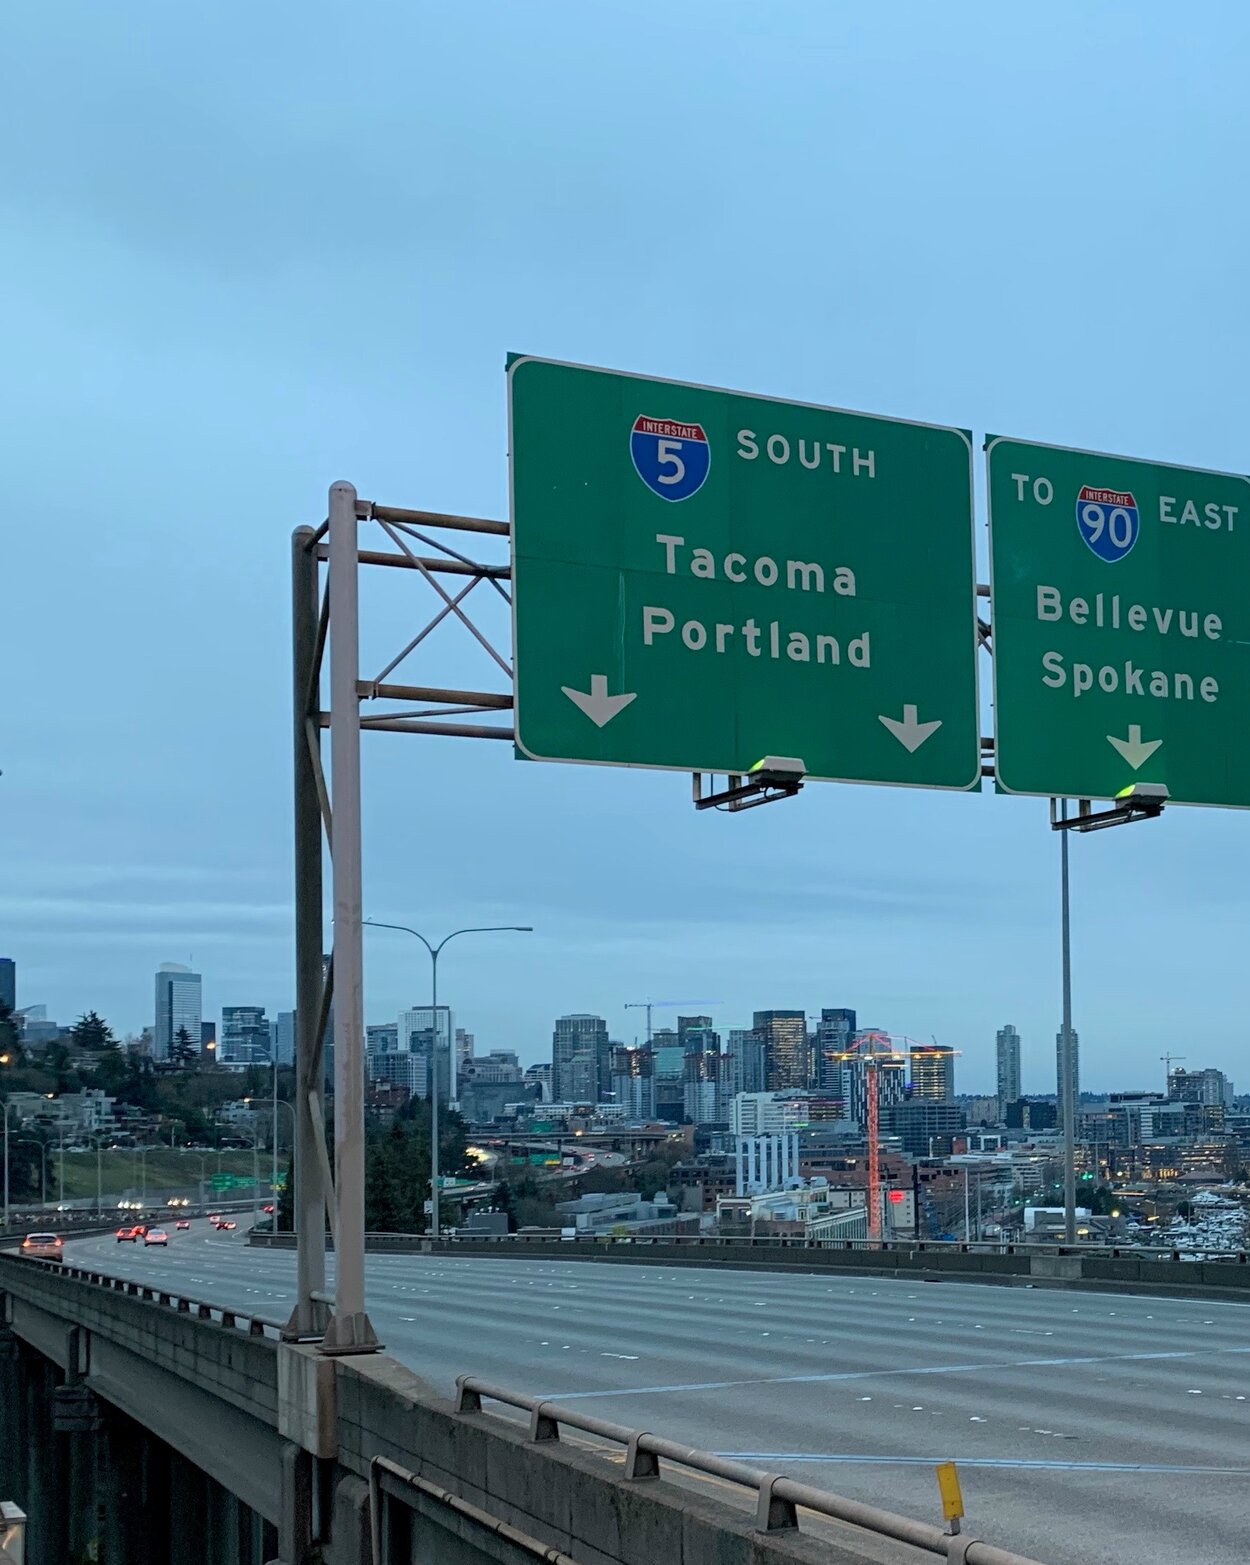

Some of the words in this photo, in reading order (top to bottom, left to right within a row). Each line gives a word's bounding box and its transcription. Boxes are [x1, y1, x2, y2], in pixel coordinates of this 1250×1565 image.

[643, 421, 697, 438] INTERSTATE
[658, 439, 685, 484] 5
[737, 429, 876, 478] SOUTH
[1011, 473, 1054, 505] TO
[1085, 490, 1129, 505] INTERSTATE
[1082, 504, 1132, 548] 90
[1159, 496, 1239, 531] EAST
[656, 534, 856, 597] Tacoma
[1037, 585, 1222, 640] Bellevue
[643, 606, 871, 668] Portland
[1042, 651, 1219, 703] Spokane
